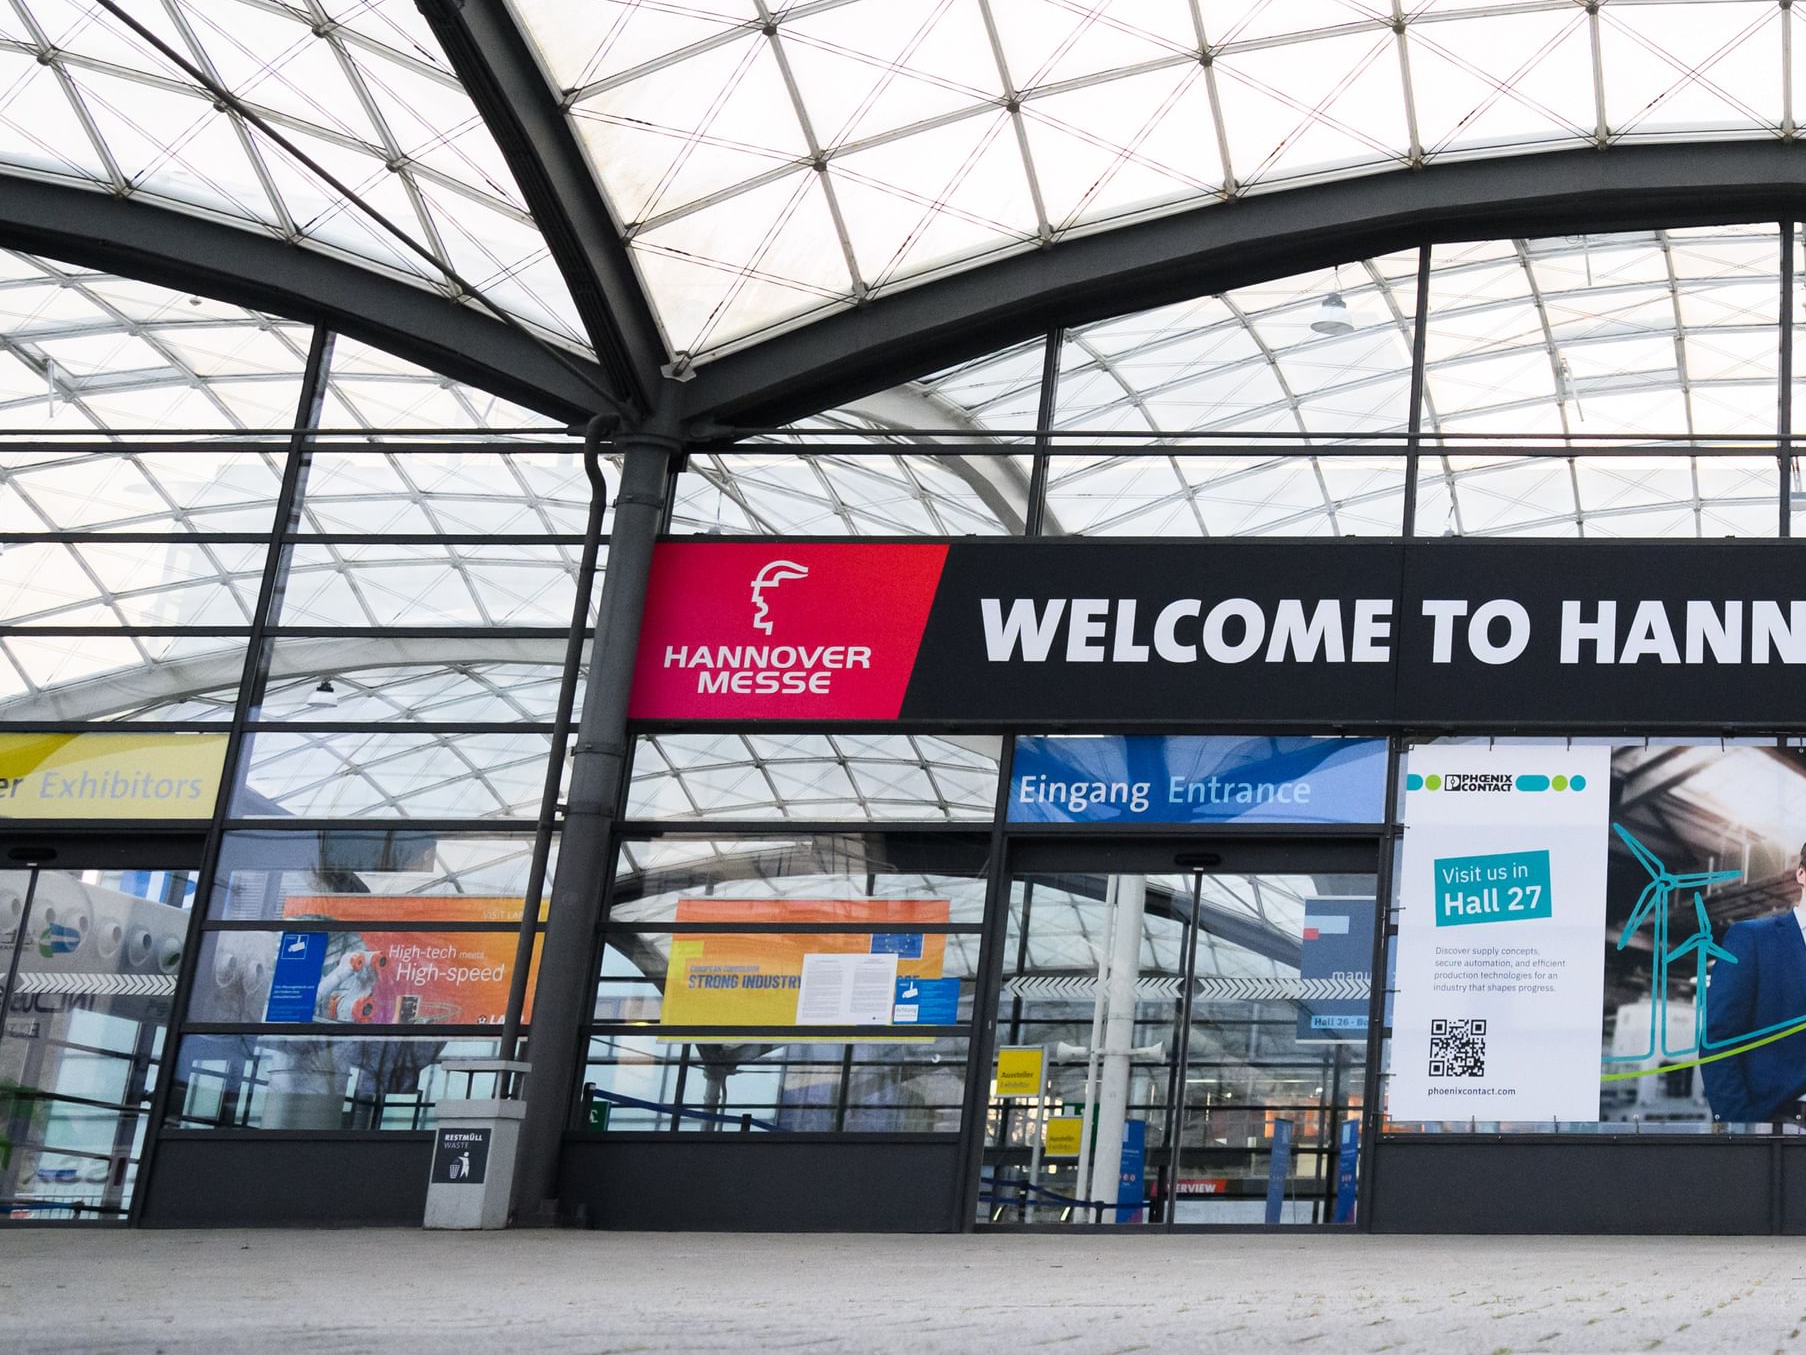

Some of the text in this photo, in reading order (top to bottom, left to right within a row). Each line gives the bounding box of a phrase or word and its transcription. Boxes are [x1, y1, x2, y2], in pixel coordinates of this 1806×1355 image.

[980, 598, 1394, 664] WELCOME
[1422, 599, 1531, 665] TO
[664, 645, 872, 669] HANNOVER
[697, 671, 832, 694] MESSE
[40, 771, 203, 799] Exhibitors
[1019, 774, 1312, 813] Eingang Entrance
[1461, 783, 1513, 792] CONTACT
[1442, 862, 1528, 884] Visit us in
[1444, 885, 1542, 916] Hall 27
[389, 944, 457, 960] High-tech
[1435, 946, 1470, 955] Discover
[1472, 946, 1499, 957] supply
[1515, 959, 1530, 967] and
[1532, 959, 1566, 967] efficient
[396, 963, 505, 987] High-speed
[688, 974, 739, 989] STRONG
[1434, 971, 1479, 981] production
[1481, 971, 1533, 982] technologies
[1534, 971, 1546, 980] for
[1433, 984, 1467, 993] industry
[1469, 984, 1485, 992] that
[1487, 984, 1516, 994] shapes
[1427, 1087, 1517, 1097] phoenixcontact.com
